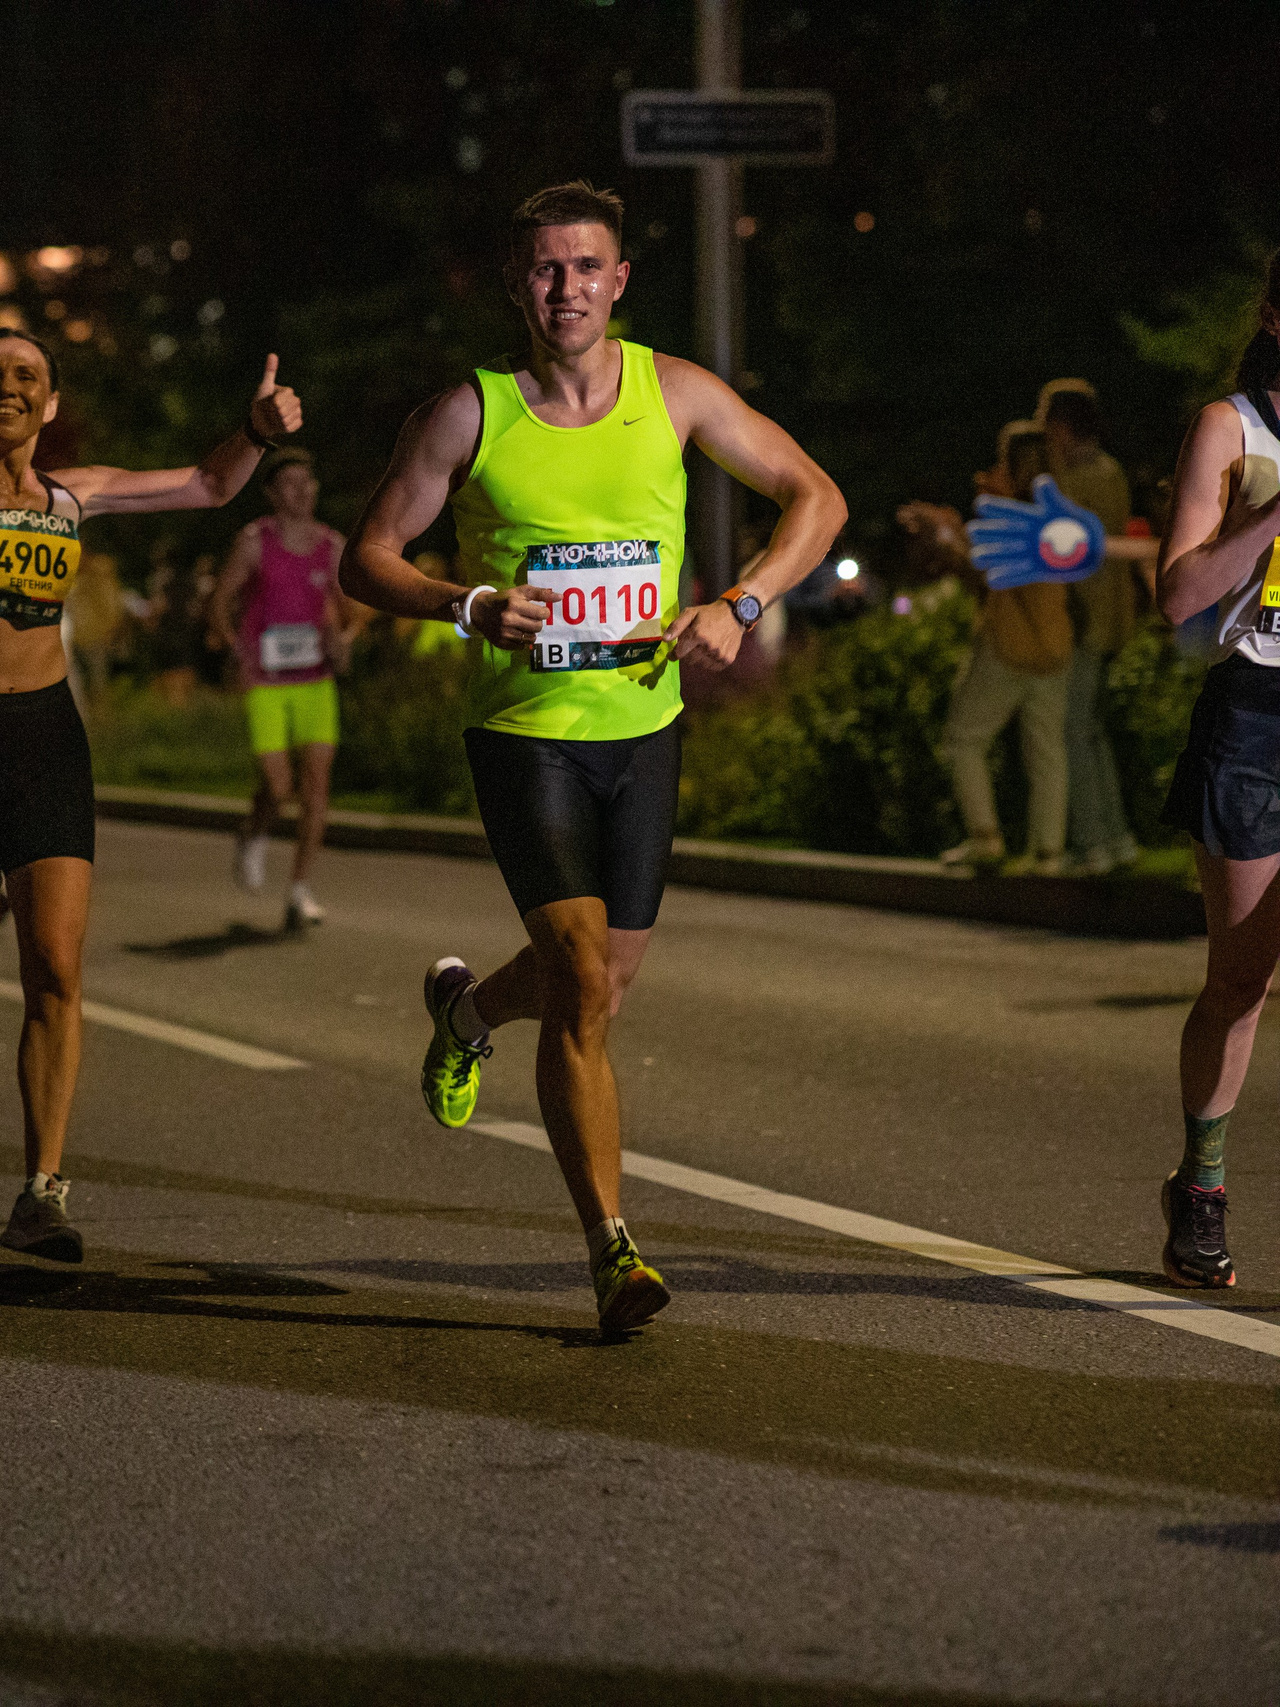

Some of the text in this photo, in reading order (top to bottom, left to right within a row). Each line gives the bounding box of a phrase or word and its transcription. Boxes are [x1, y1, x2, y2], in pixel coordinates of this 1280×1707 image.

[541, 540, 650, 564] НОЧНОЙ
[9, 577, 54, 592] ЕВГЕНИЯ
[1269, 590, 1280, 602] VI
